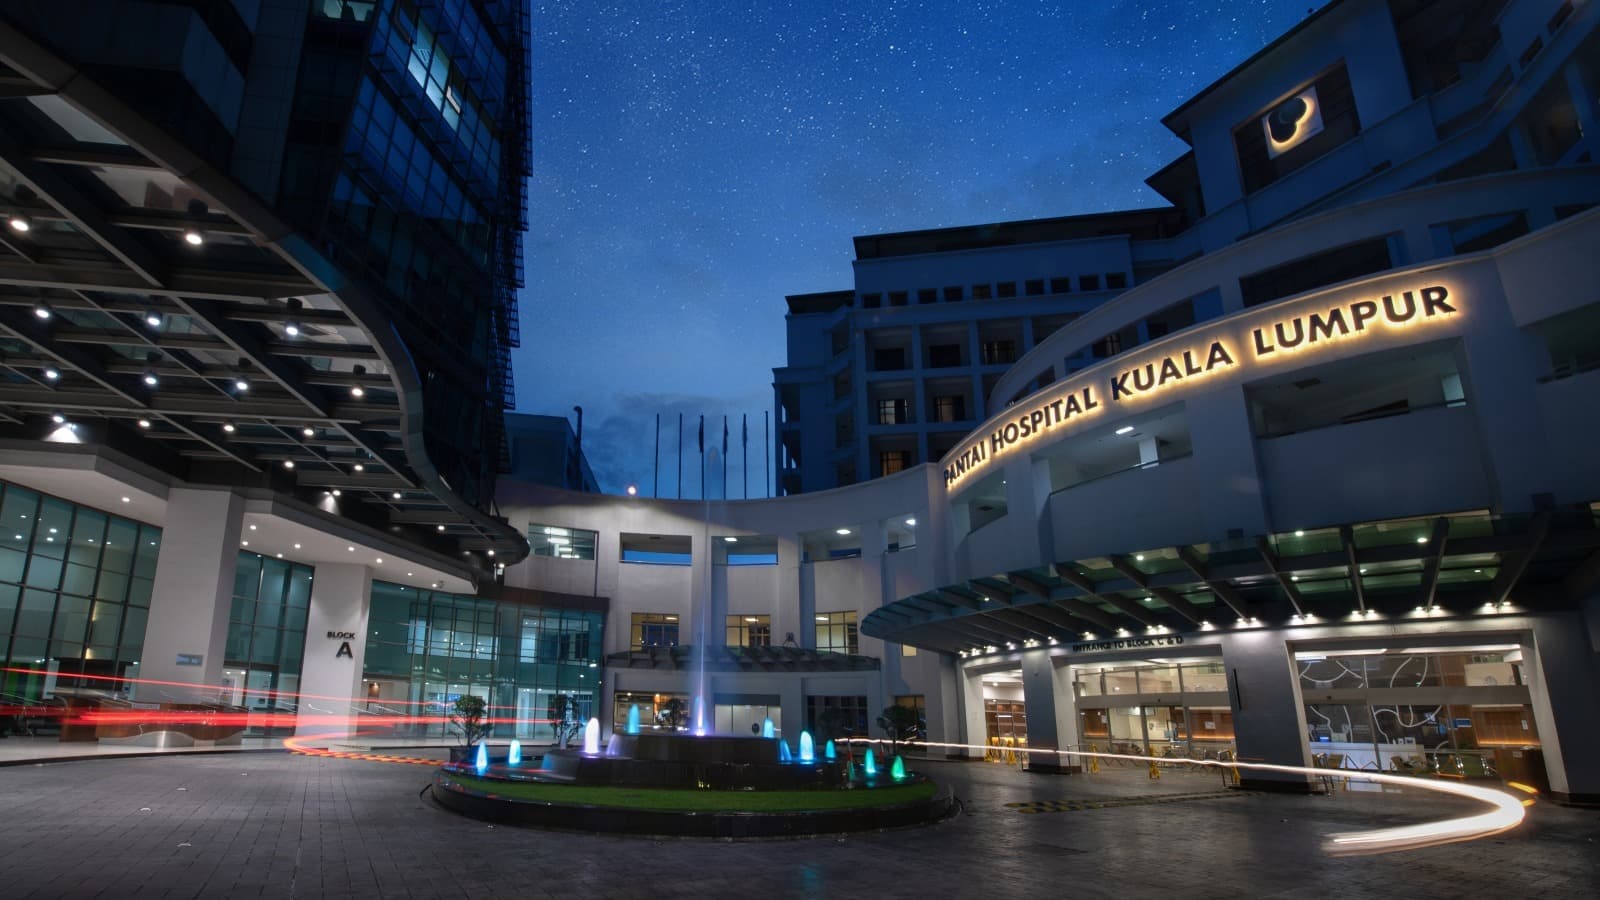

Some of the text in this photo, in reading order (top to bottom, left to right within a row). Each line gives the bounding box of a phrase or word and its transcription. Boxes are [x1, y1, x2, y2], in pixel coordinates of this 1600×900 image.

[943, 285, 1457, 489] PANTAI HOSPITAL KUALA LUMPUR
[327, 631, 355, 640] BLOCK
[335, 641, 353, 658] A
[1072, 641, 1112, 652] ENTRANCE
[1114, 640, 1124, 649] TO
[1127, 638, 1154, 649] BLOCK
